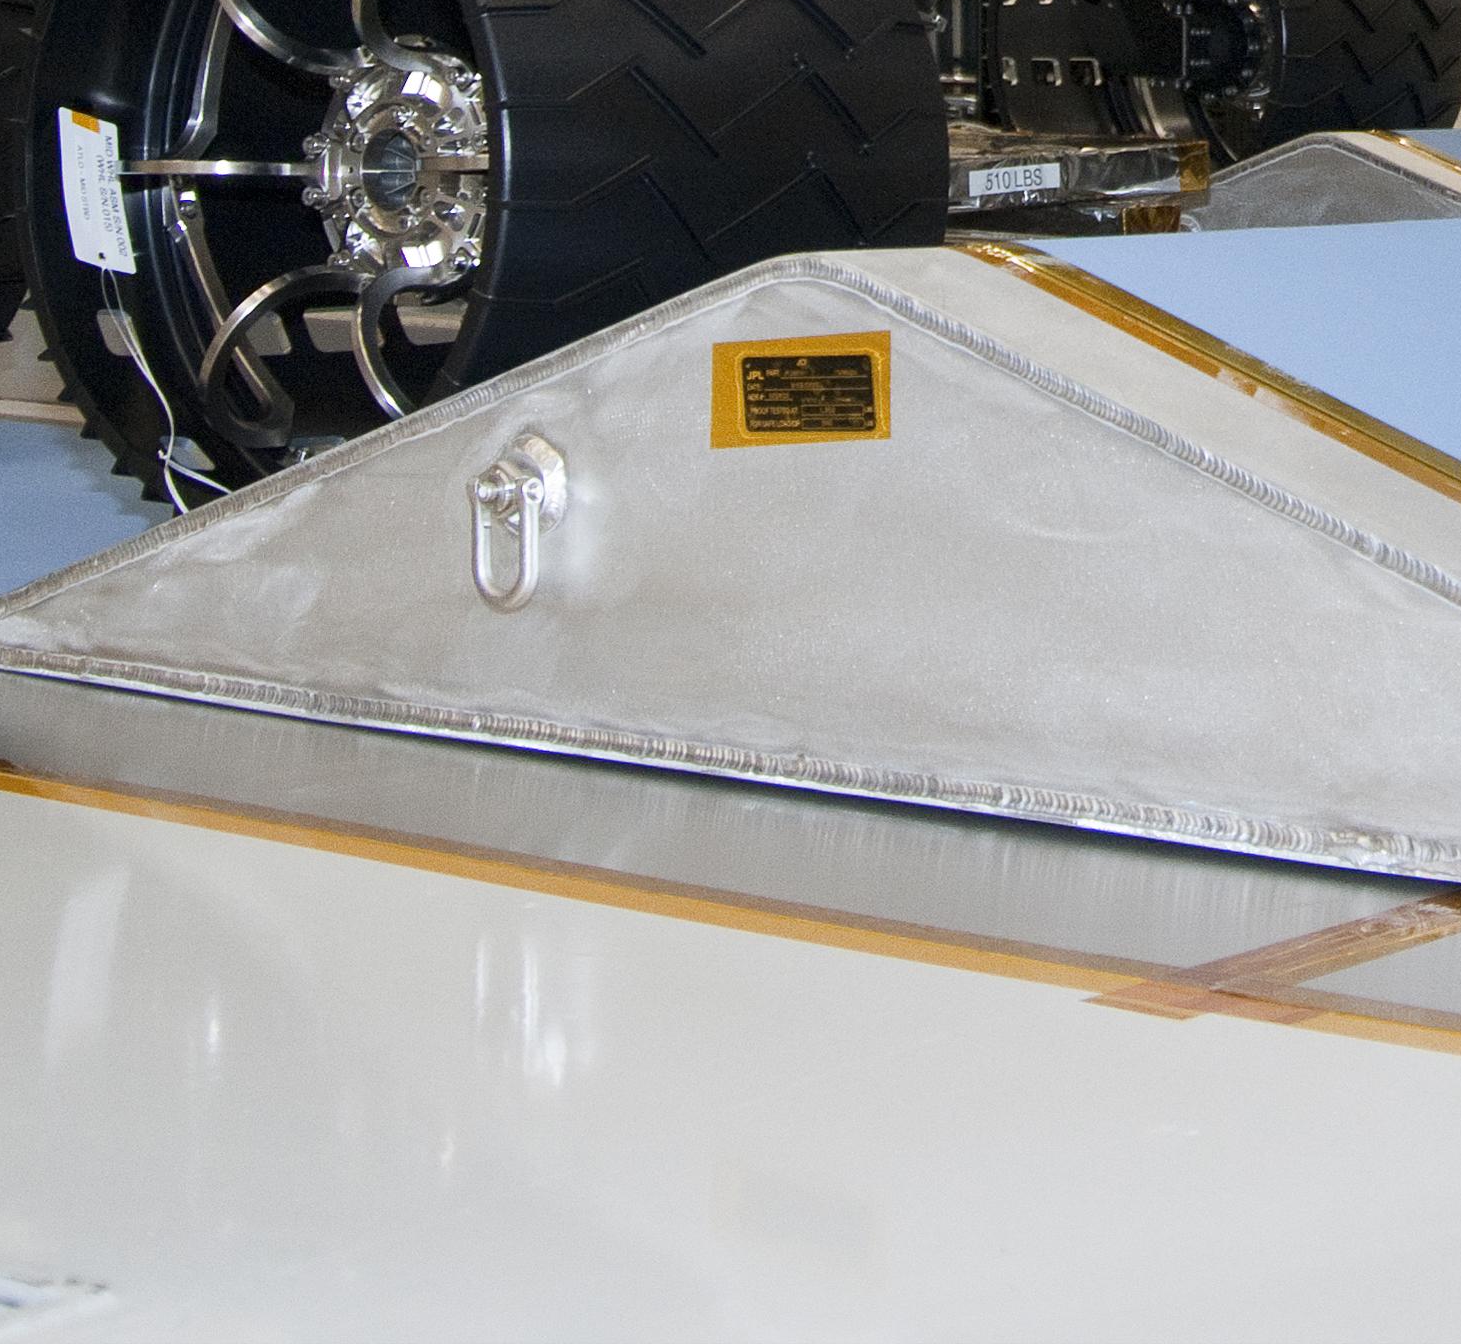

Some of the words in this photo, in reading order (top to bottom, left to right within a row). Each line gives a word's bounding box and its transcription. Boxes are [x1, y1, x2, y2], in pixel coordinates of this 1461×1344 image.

[104, 135, 115, 160] MID
[984, 171, 1011, 191] 510
[1014, 168, 1043, 188] LBS
[747, 370, 764, 381] JPL
